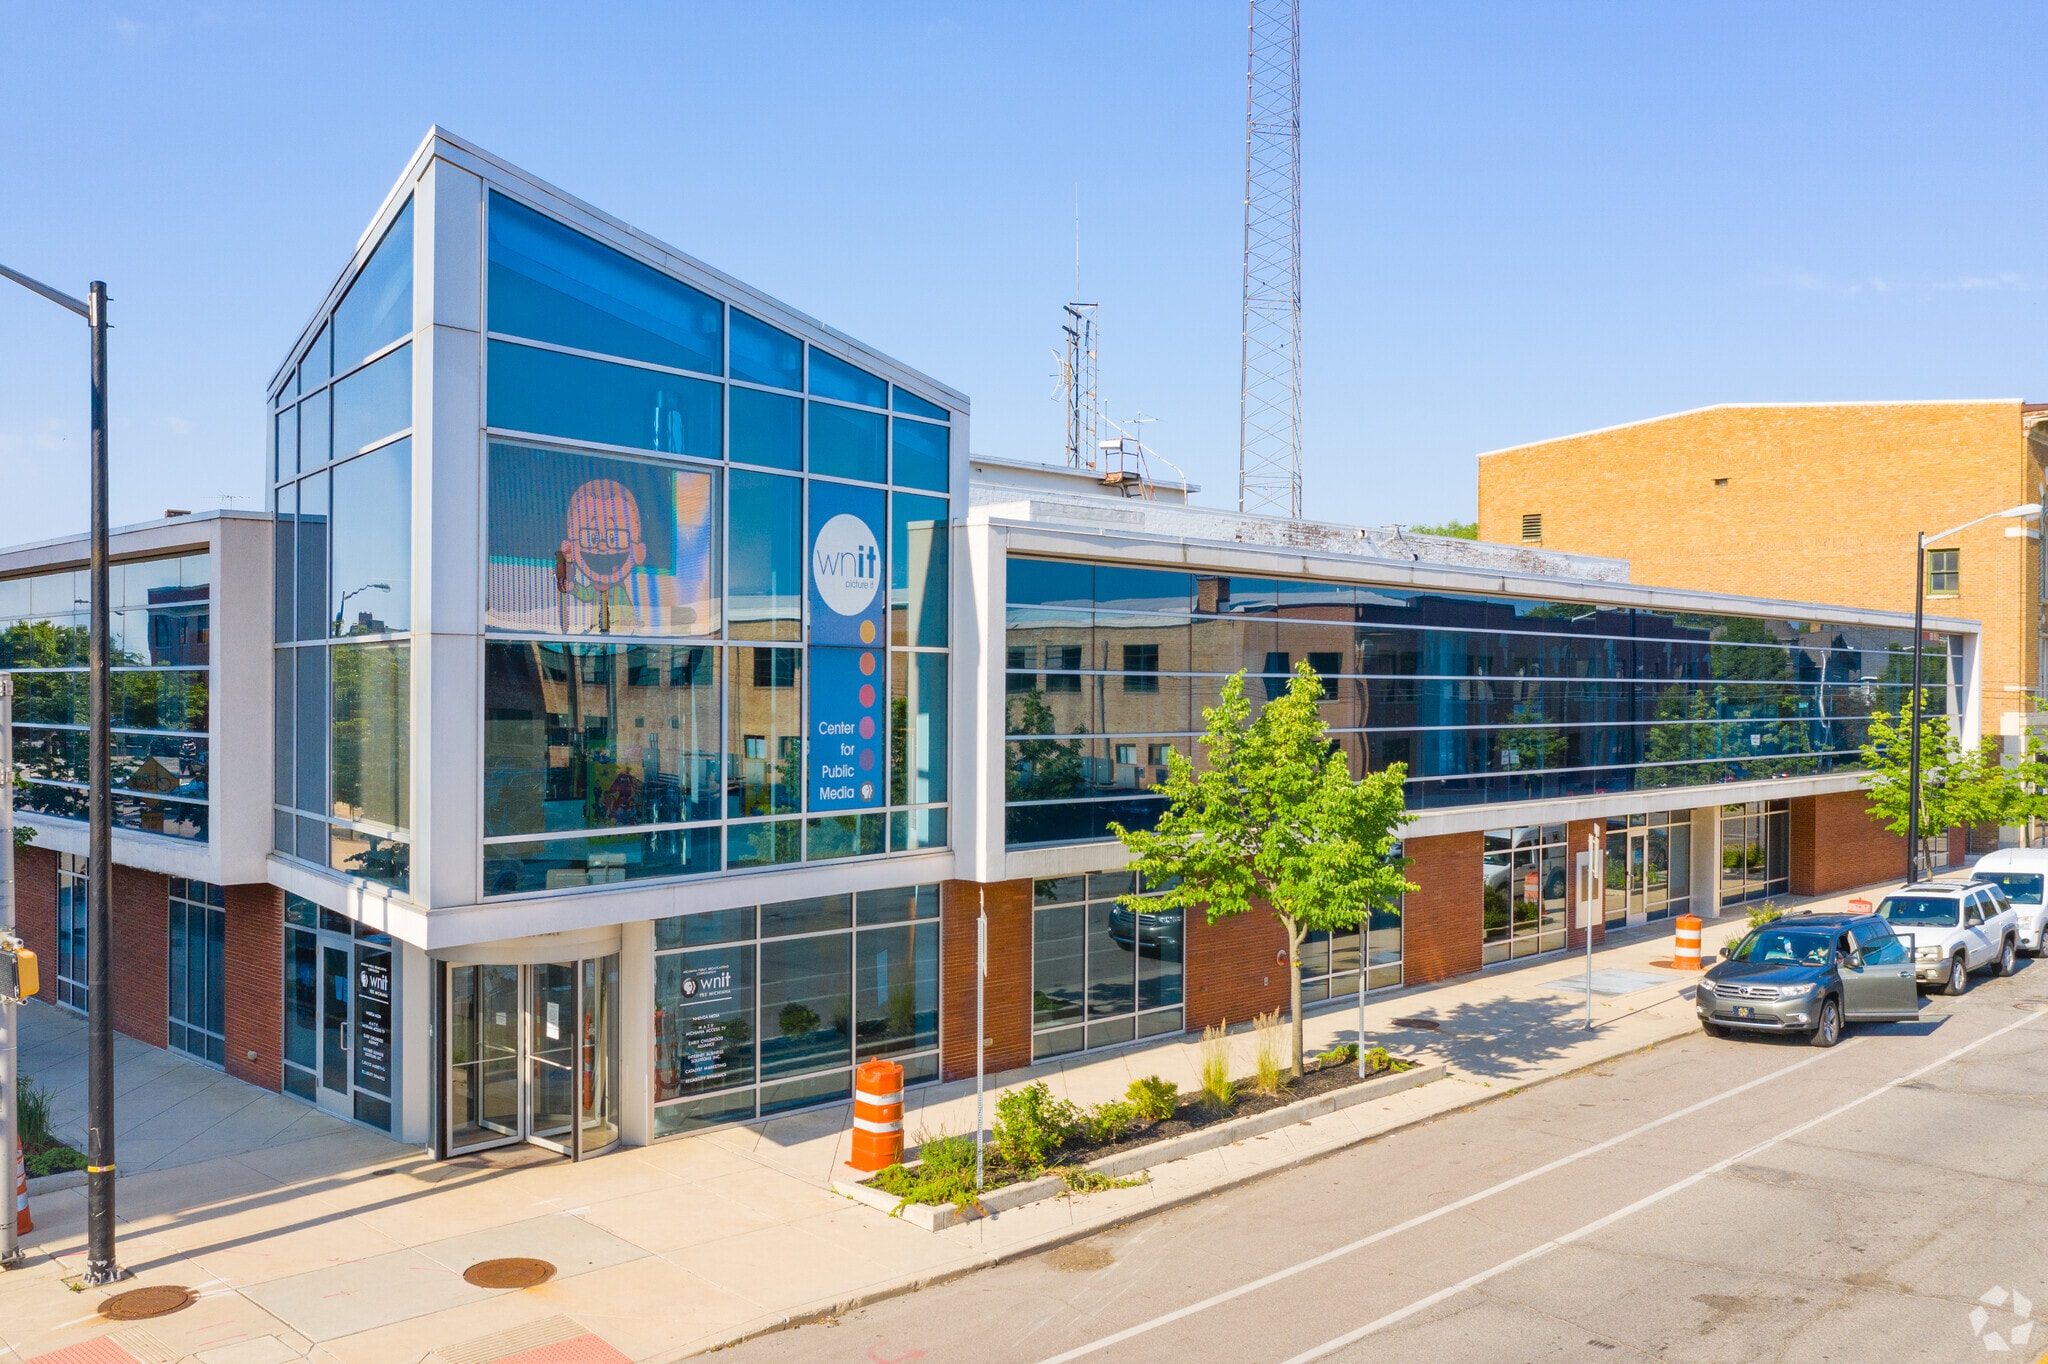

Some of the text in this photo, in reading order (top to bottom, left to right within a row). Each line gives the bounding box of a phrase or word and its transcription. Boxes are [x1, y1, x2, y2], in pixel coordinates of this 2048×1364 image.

[817, 545, 877, 579] wnit
[845, 580, 869, 590] picture
[818, 721, 856, 736] Center
[840, 743, 856, 756] for
[822, 764, 855, 779] Public
[819, 785, 855, 801] Media
[370, 974, 389, 991] wnit
[700, 972, 731, 990] wnit
